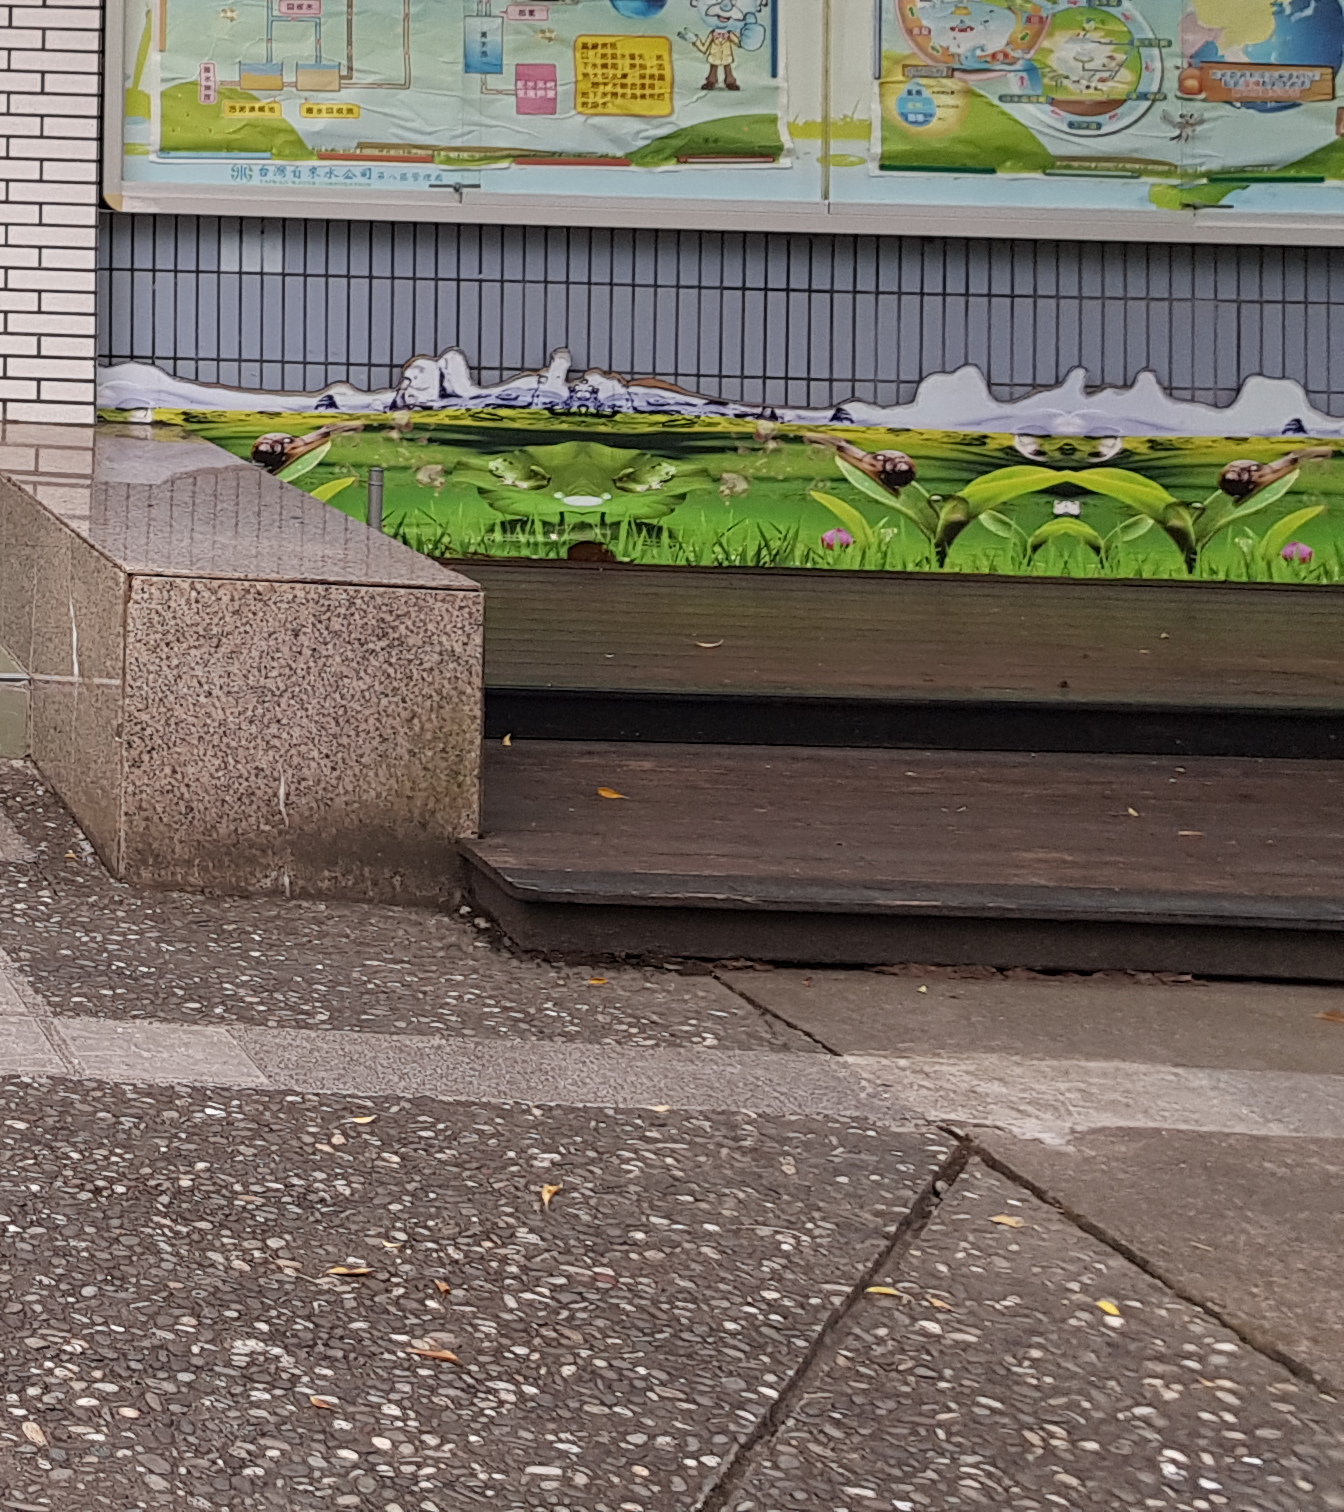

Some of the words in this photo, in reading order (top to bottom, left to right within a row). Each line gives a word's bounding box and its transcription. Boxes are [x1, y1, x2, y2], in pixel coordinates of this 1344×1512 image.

[258, 165, 373, 182] 台灣自來水公司
